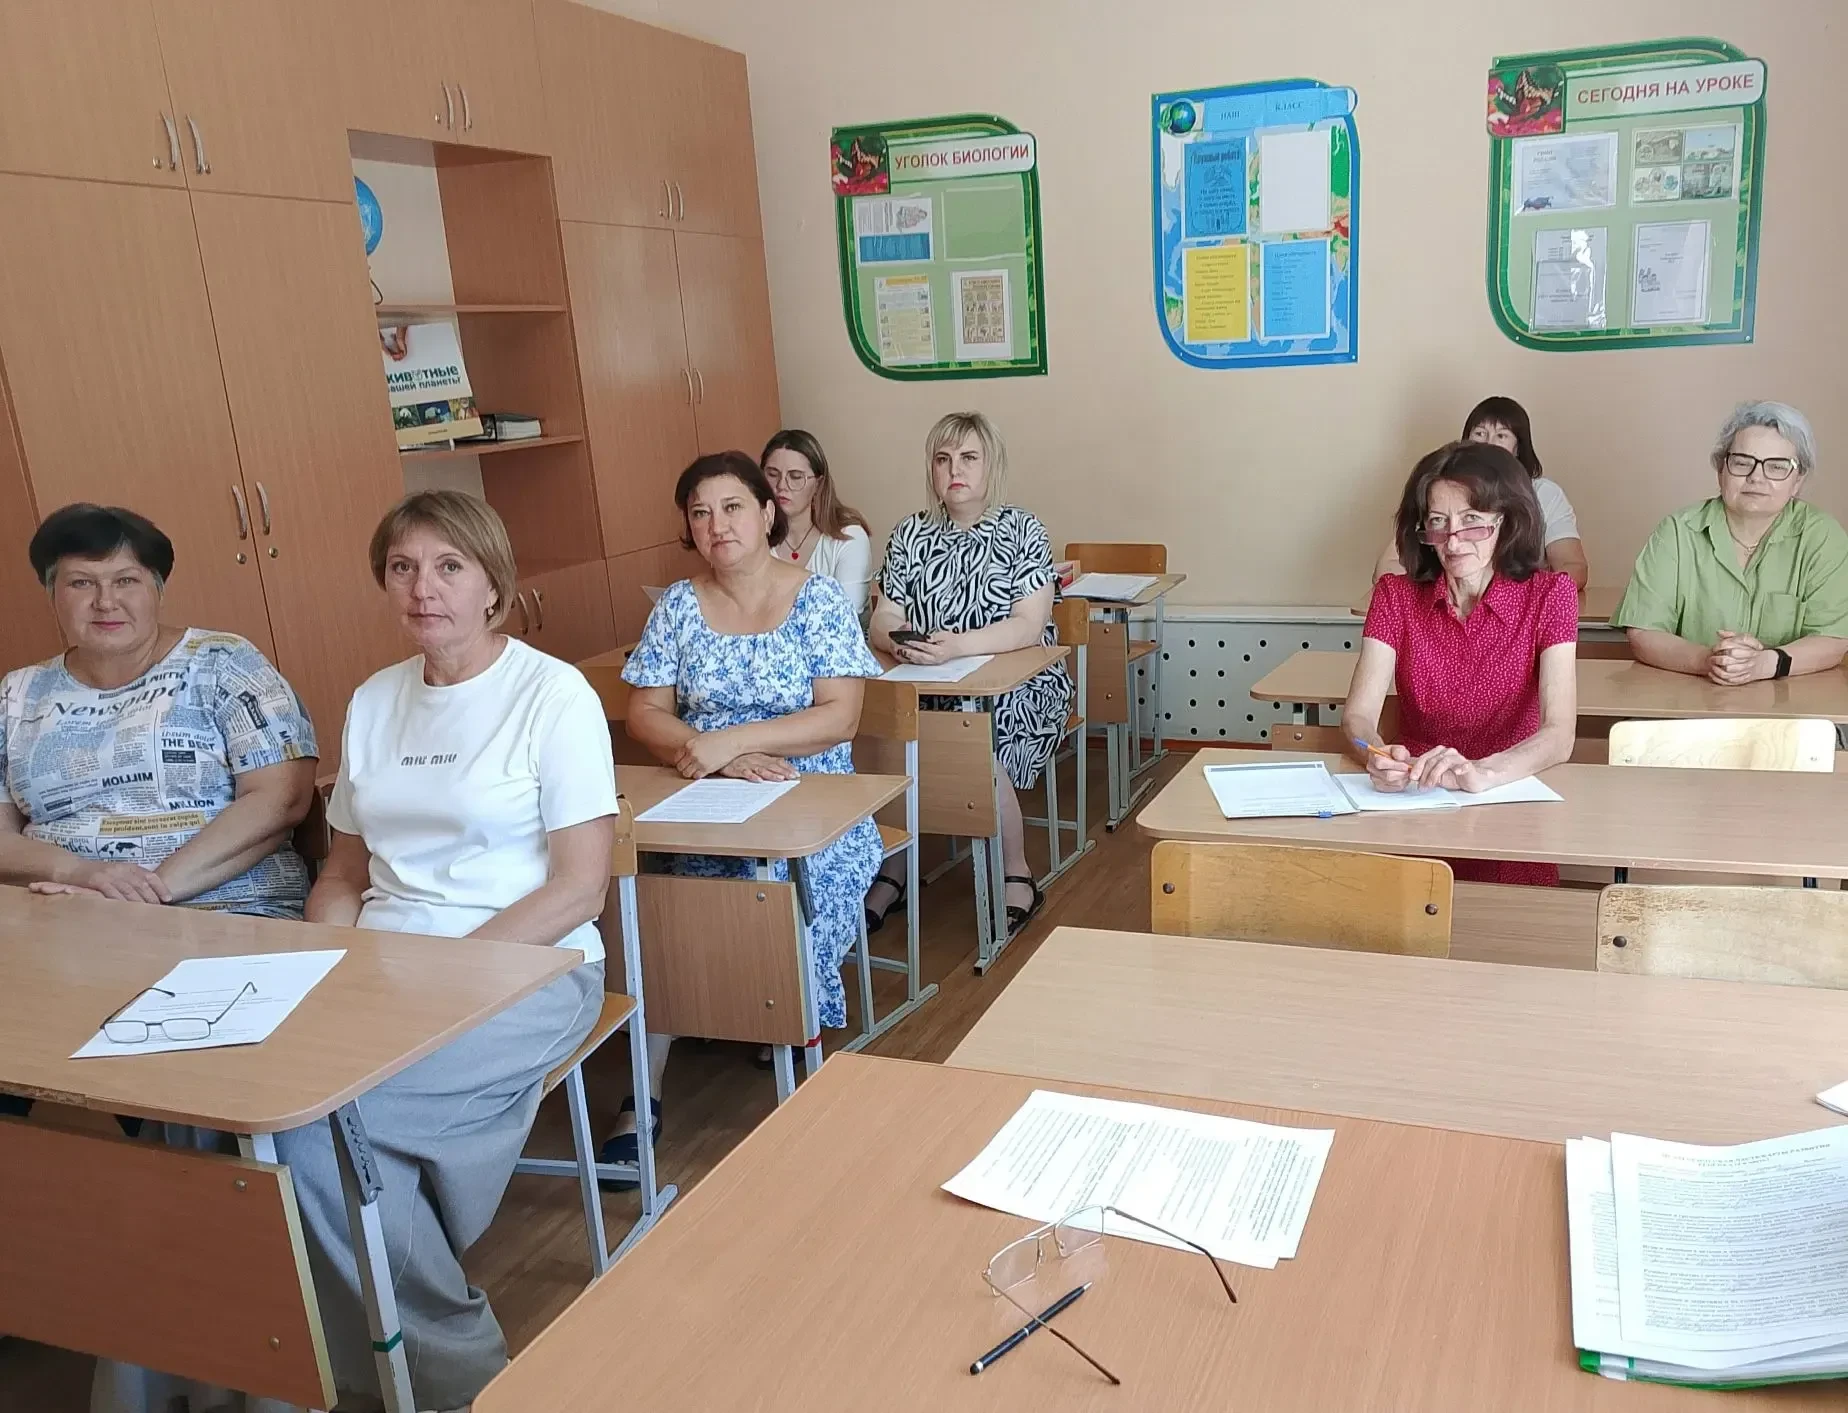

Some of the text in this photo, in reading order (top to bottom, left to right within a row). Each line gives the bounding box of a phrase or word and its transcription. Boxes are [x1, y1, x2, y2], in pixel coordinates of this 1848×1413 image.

[1577, 73, 1755, 104] СЕГОДНЯ НА УРОКЕ
[894, 143, 1029, 170] УГОЛОК БИОЛОГИИ
[388, 381, 417, 393] ашей
[161, 738, 184, 748] THE
